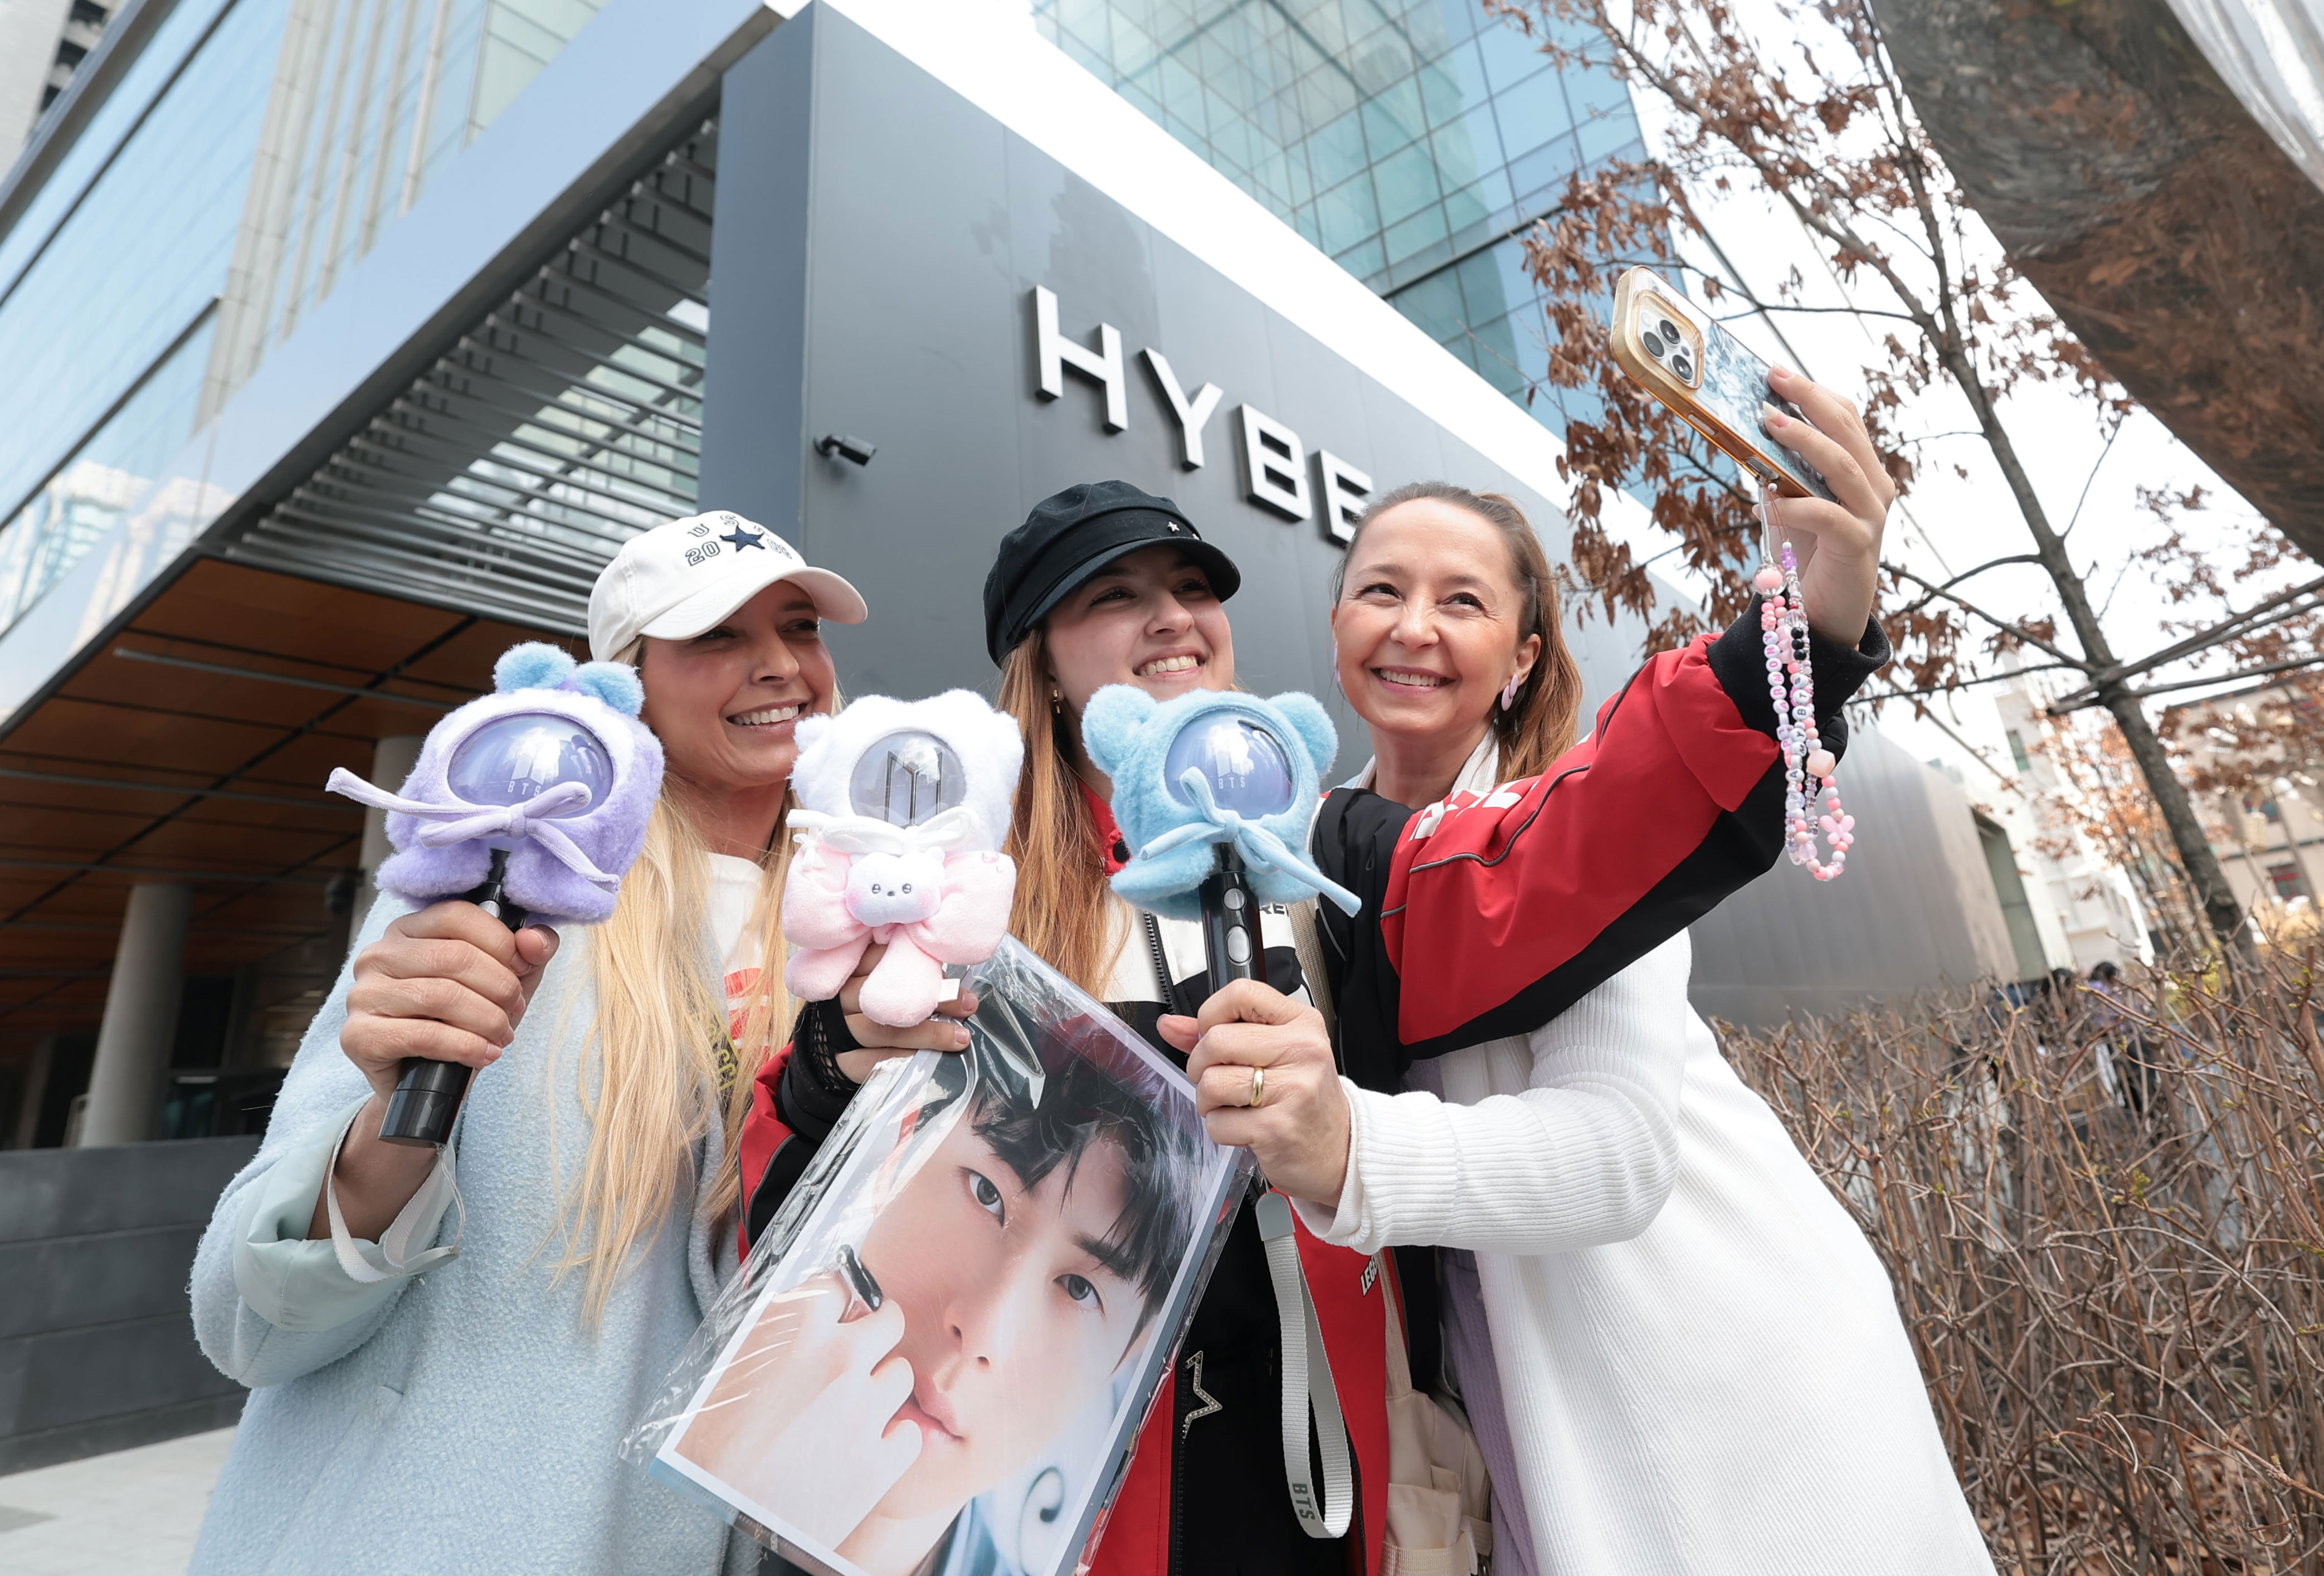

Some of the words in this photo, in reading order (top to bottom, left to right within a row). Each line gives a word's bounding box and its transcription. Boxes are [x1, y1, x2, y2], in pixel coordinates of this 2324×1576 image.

[1035, 284, 1373, 549] HYBE
[1789, 731, 1806, 779] AMY
[507, 780, 542, 797] BTS
[1218, 776, 1245, 789] BTS
[1292, 1483, 1316, 1520] BTS
